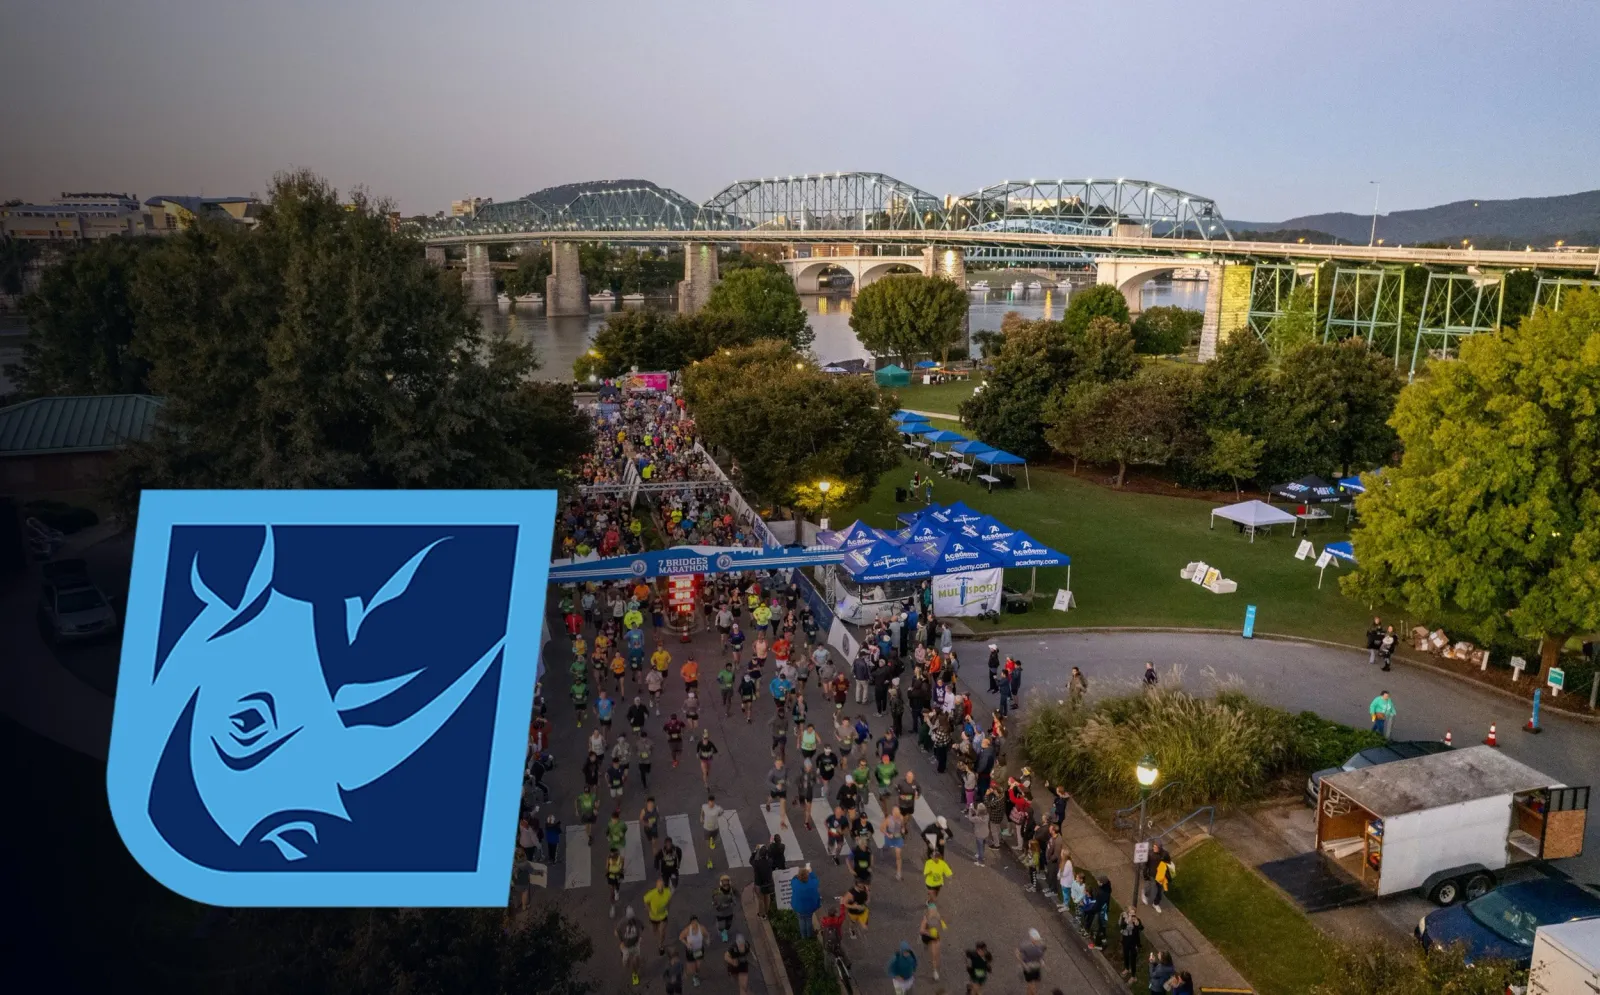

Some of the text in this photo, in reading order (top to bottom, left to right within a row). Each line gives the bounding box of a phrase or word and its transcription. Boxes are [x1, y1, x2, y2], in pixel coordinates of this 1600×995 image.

[945, 551, 979, 561] Academy
[666, 557, 708, 567] BRIDGES
[658, 564, 708, 573] MARATHON
[946, 562, 990, 573] academy.com
[863, 570, 930, 580] sceniccitymultisport.com
